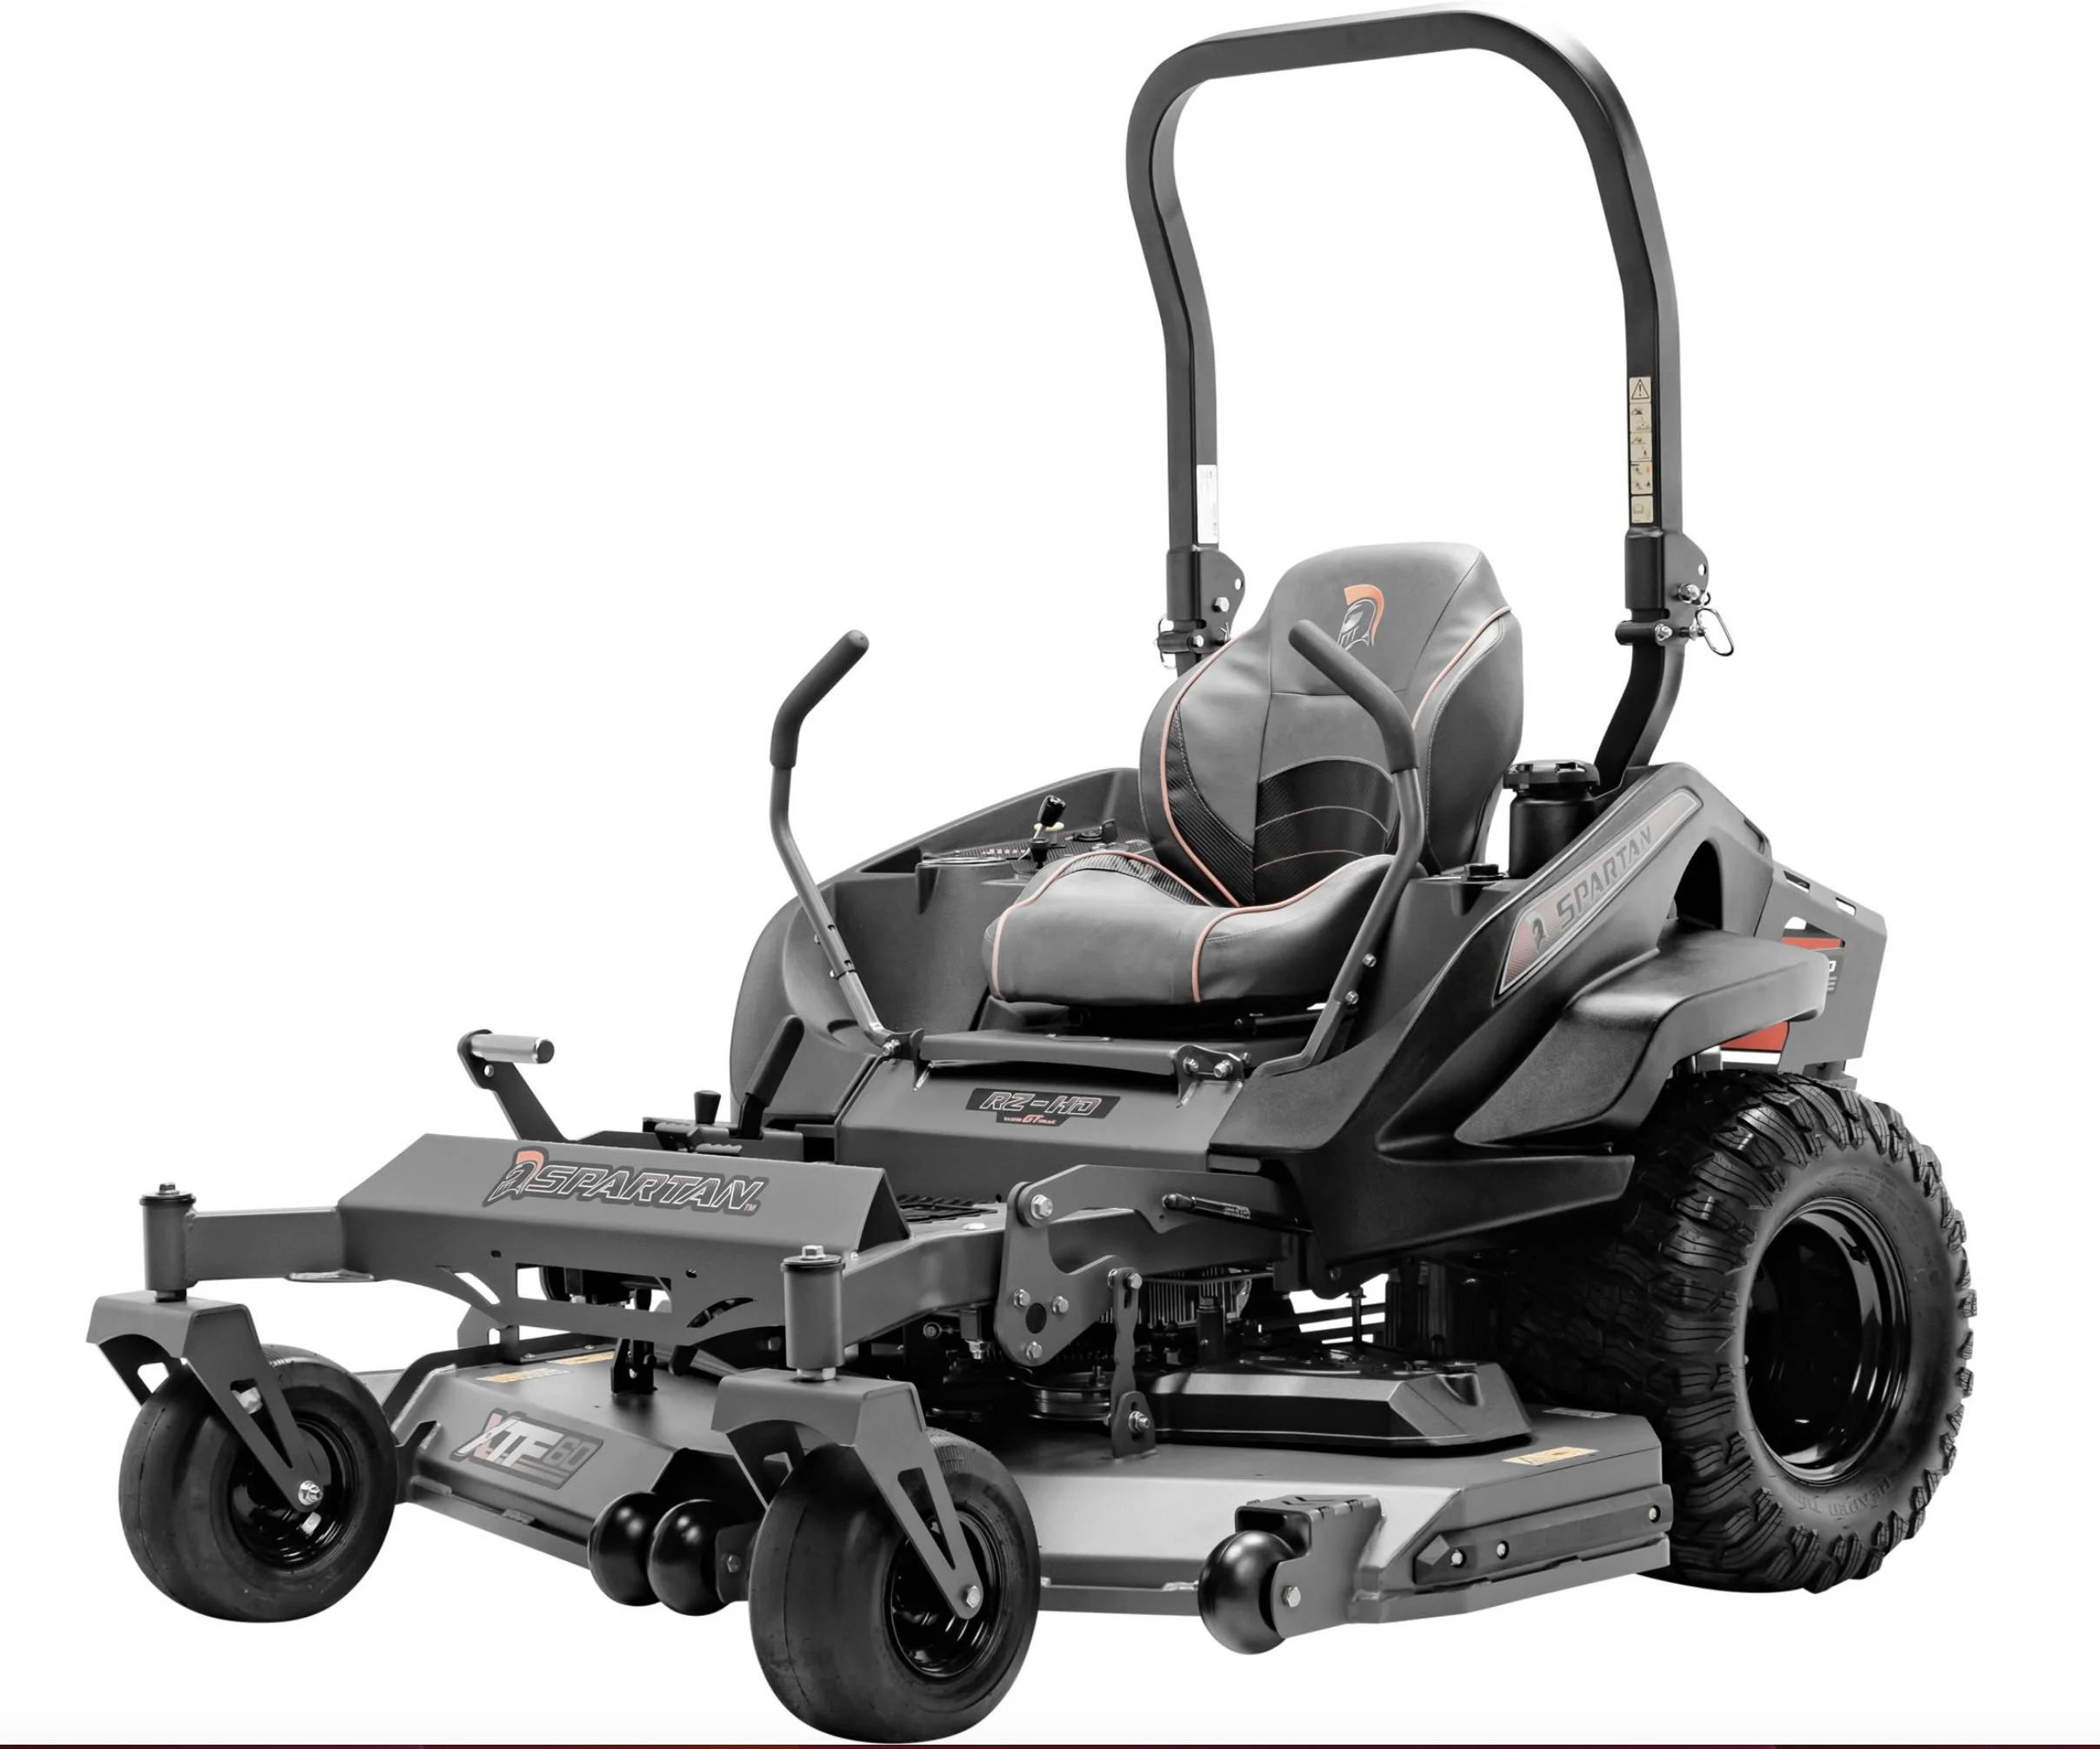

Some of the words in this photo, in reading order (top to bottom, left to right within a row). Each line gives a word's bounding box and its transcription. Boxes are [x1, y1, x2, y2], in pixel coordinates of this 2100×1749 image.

[1556, 826, 1652, 930] SPARTAN
[979, 1091, 1102, 1115] RZ-HD
[524, 1165, 763, 1210] SPARTAN
